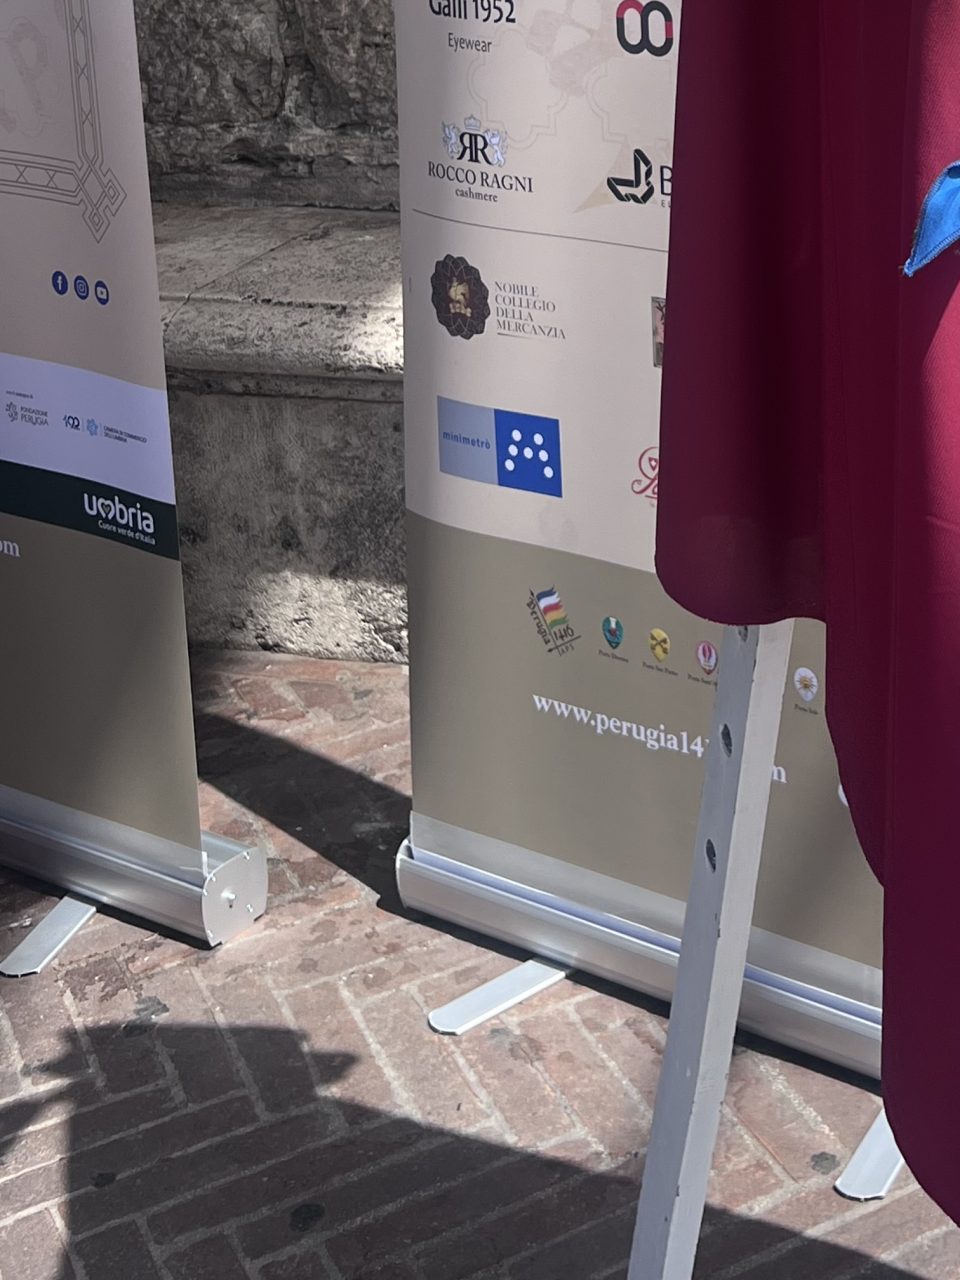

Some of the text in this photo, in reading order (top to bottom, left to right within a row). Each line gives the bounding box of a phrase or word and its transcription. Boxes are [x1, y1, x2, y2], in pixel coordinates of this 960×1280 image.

[448, 33, 492, 54] Eyewear
[428, 161, 533, 193] ROCCO RAGNI
[455, 186, 498, 203] cashmere
[495, 281, 539, 298] NOBILE
[495, 294, 556, 313] COLLEGIO
[496, 307, 533, 322] DELLA
[497, 319, 566, 340] MERCANZIA
[443, 431, 491, 449] minimetrò
